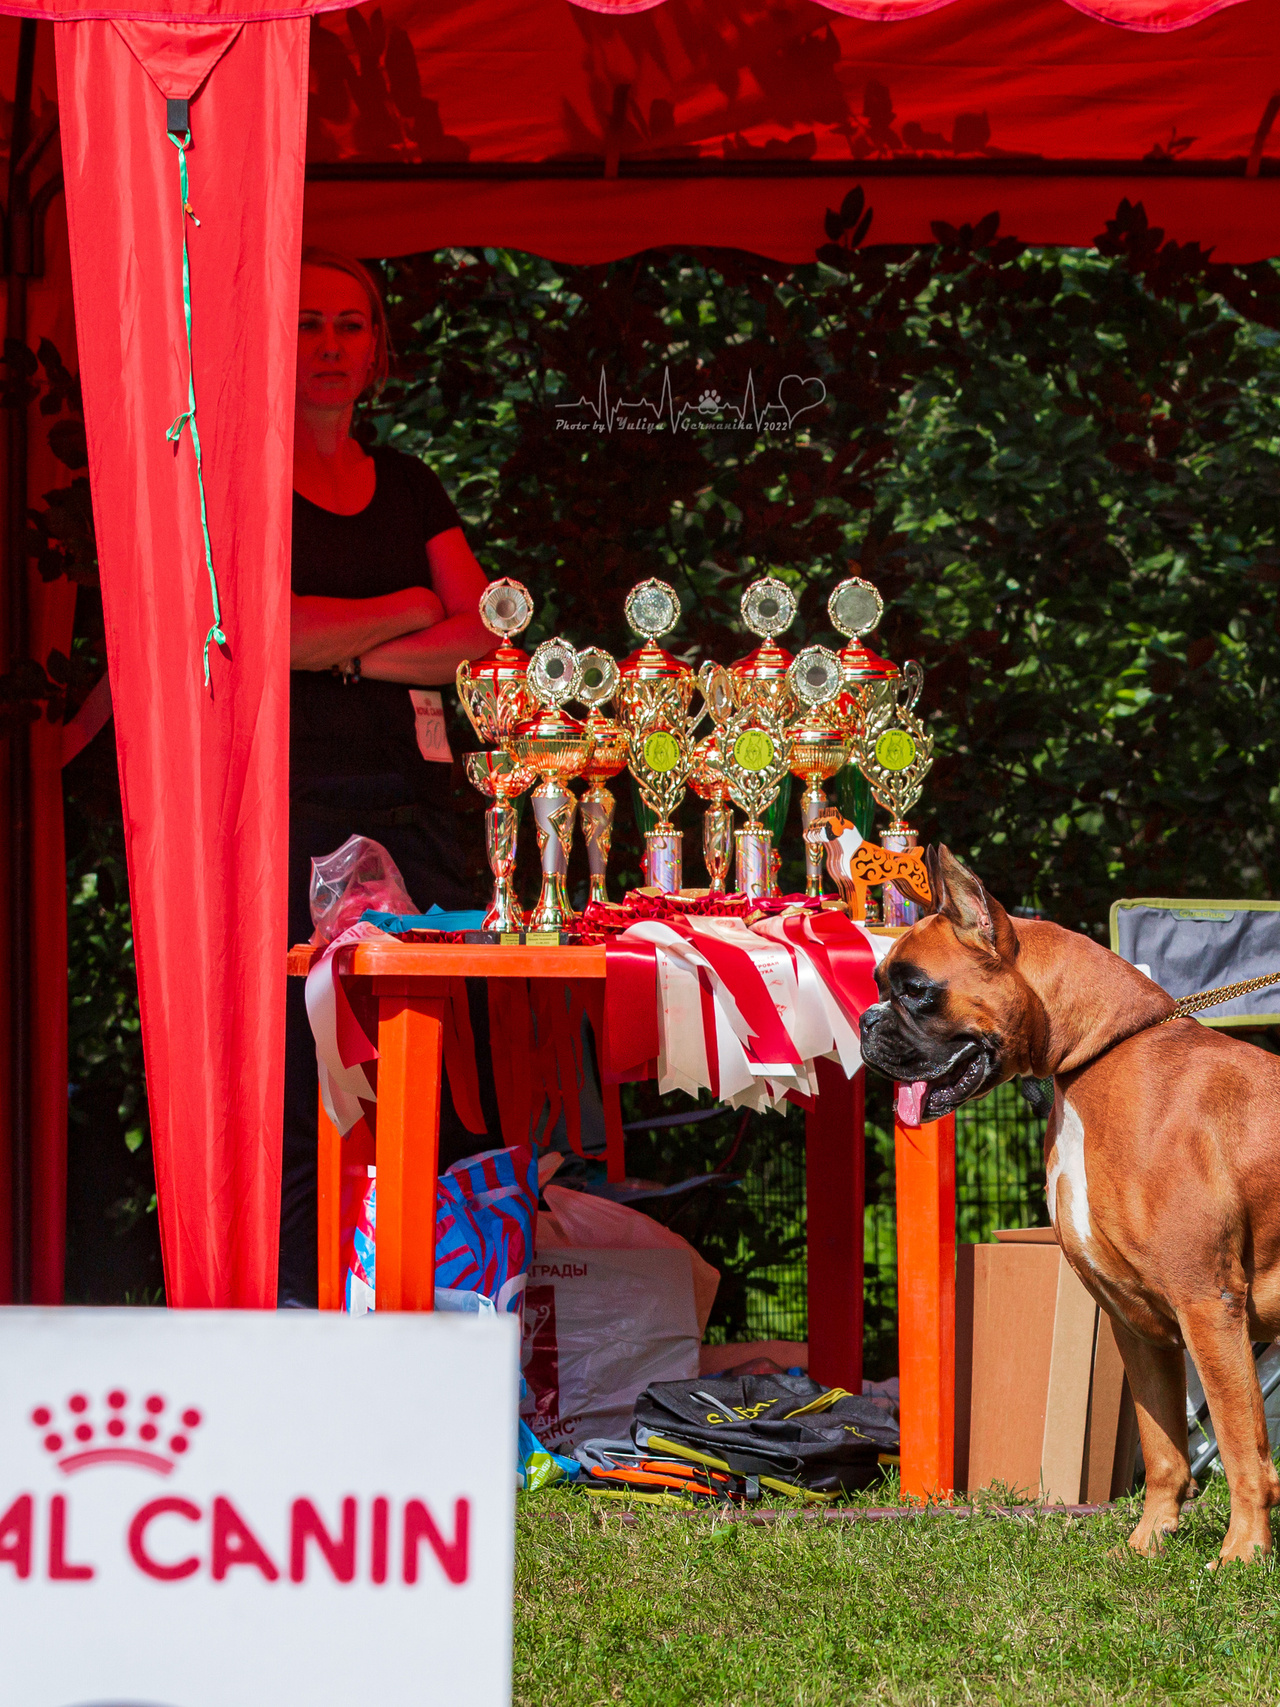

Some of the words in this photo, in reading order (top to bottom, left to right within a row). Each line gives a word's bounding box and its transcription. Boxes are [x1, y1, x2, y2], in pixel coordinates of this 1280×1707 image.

[425, 719, 442, 749] 50
[528, 1264, 588, 1279] ГРАДЫ
[0, 1493, 96, 1582] AL
[126, 1493, 472, 1586] CANIN
